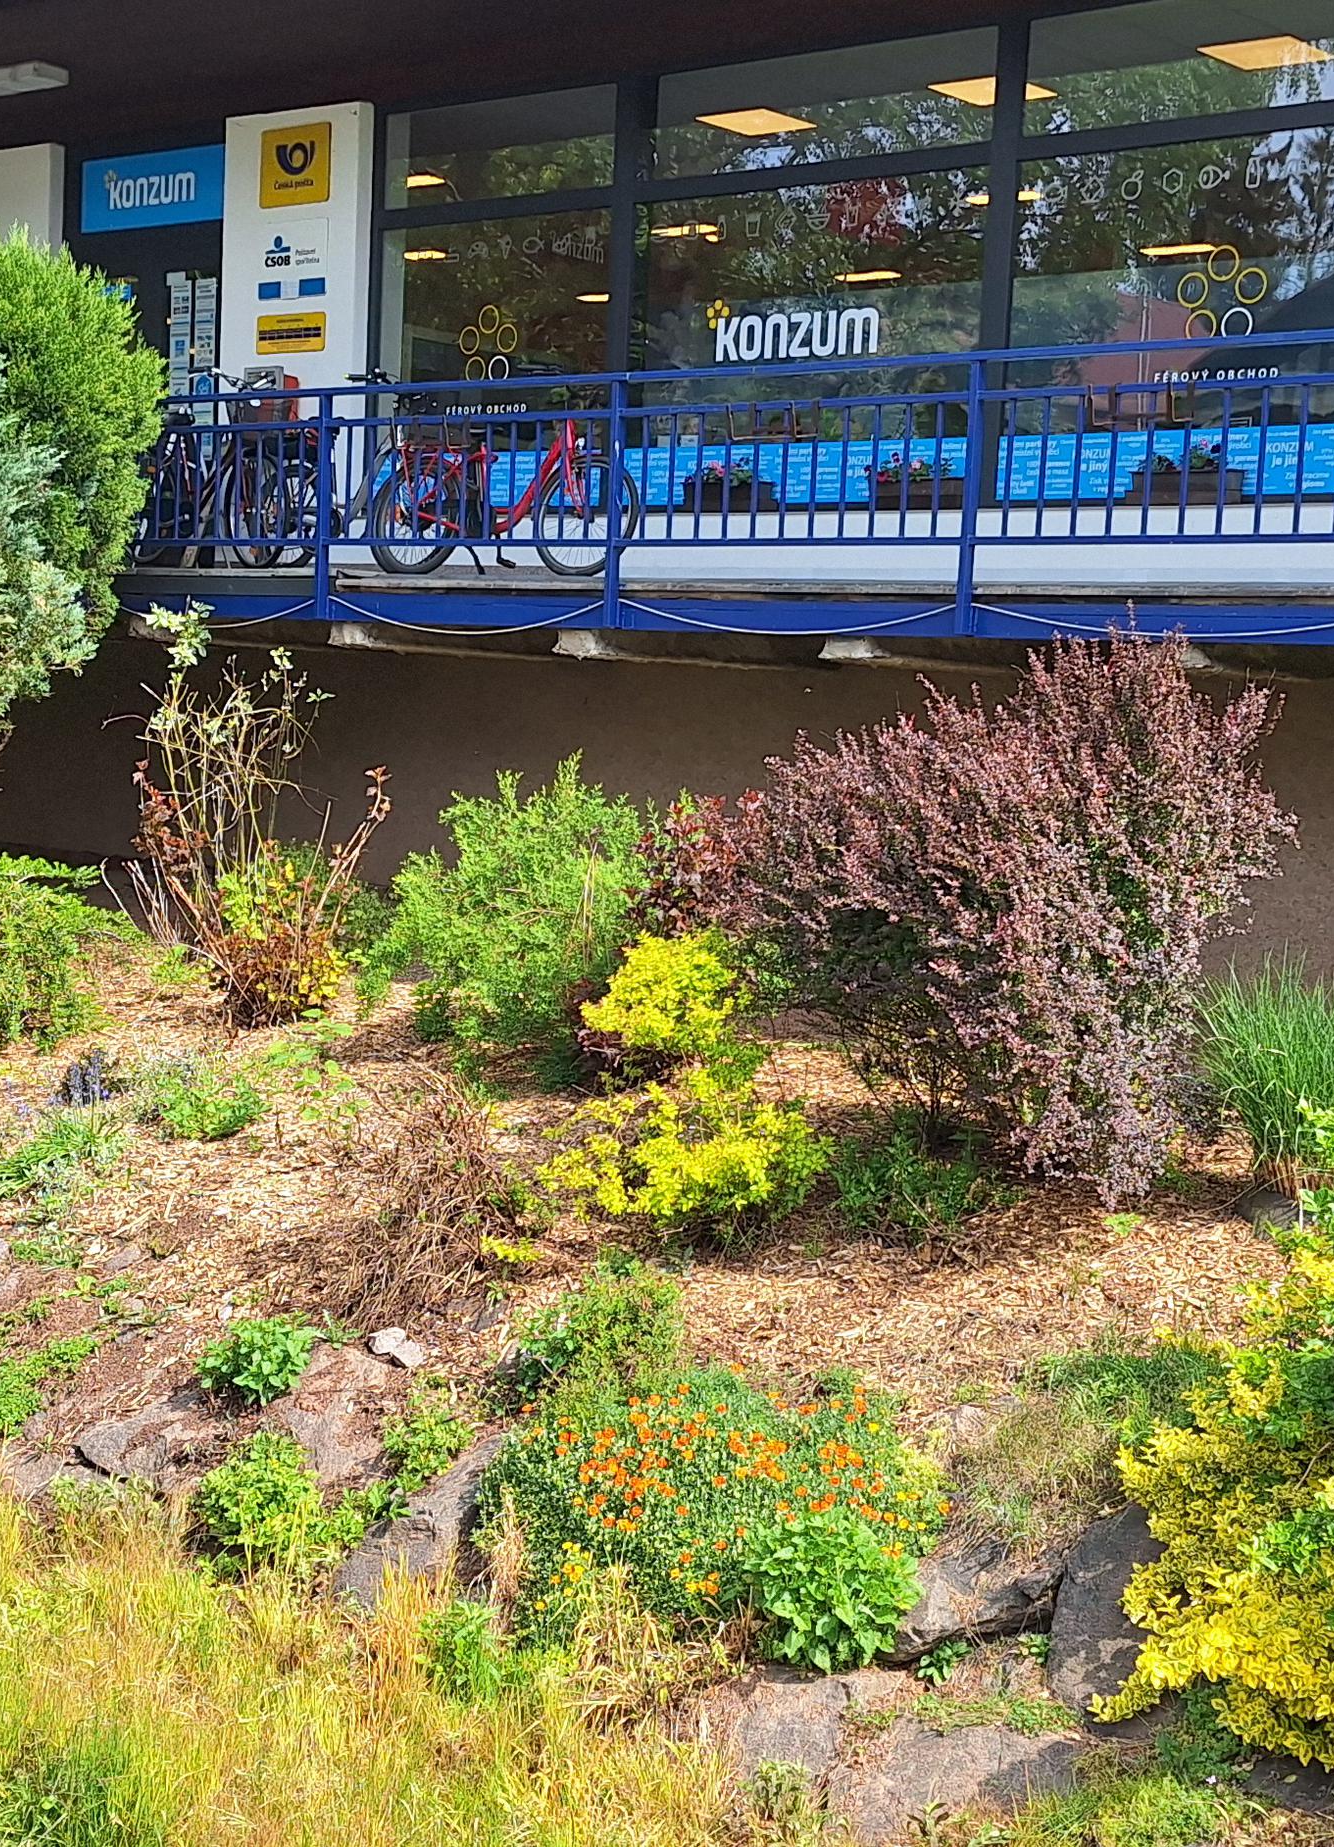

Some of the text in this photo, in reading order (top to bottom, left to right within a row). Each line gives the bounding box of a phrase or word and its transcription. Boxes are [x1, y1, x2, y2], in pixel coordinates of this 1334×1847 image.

[109, 171, 196, 211] KONZUM
[715, 307, 879, 362] KONZUM
[1153, 367, 1279, 383] FÉROVÝ OBCHOD
[446, 402, 527, 416] FÉROVÝ OBCHOD
